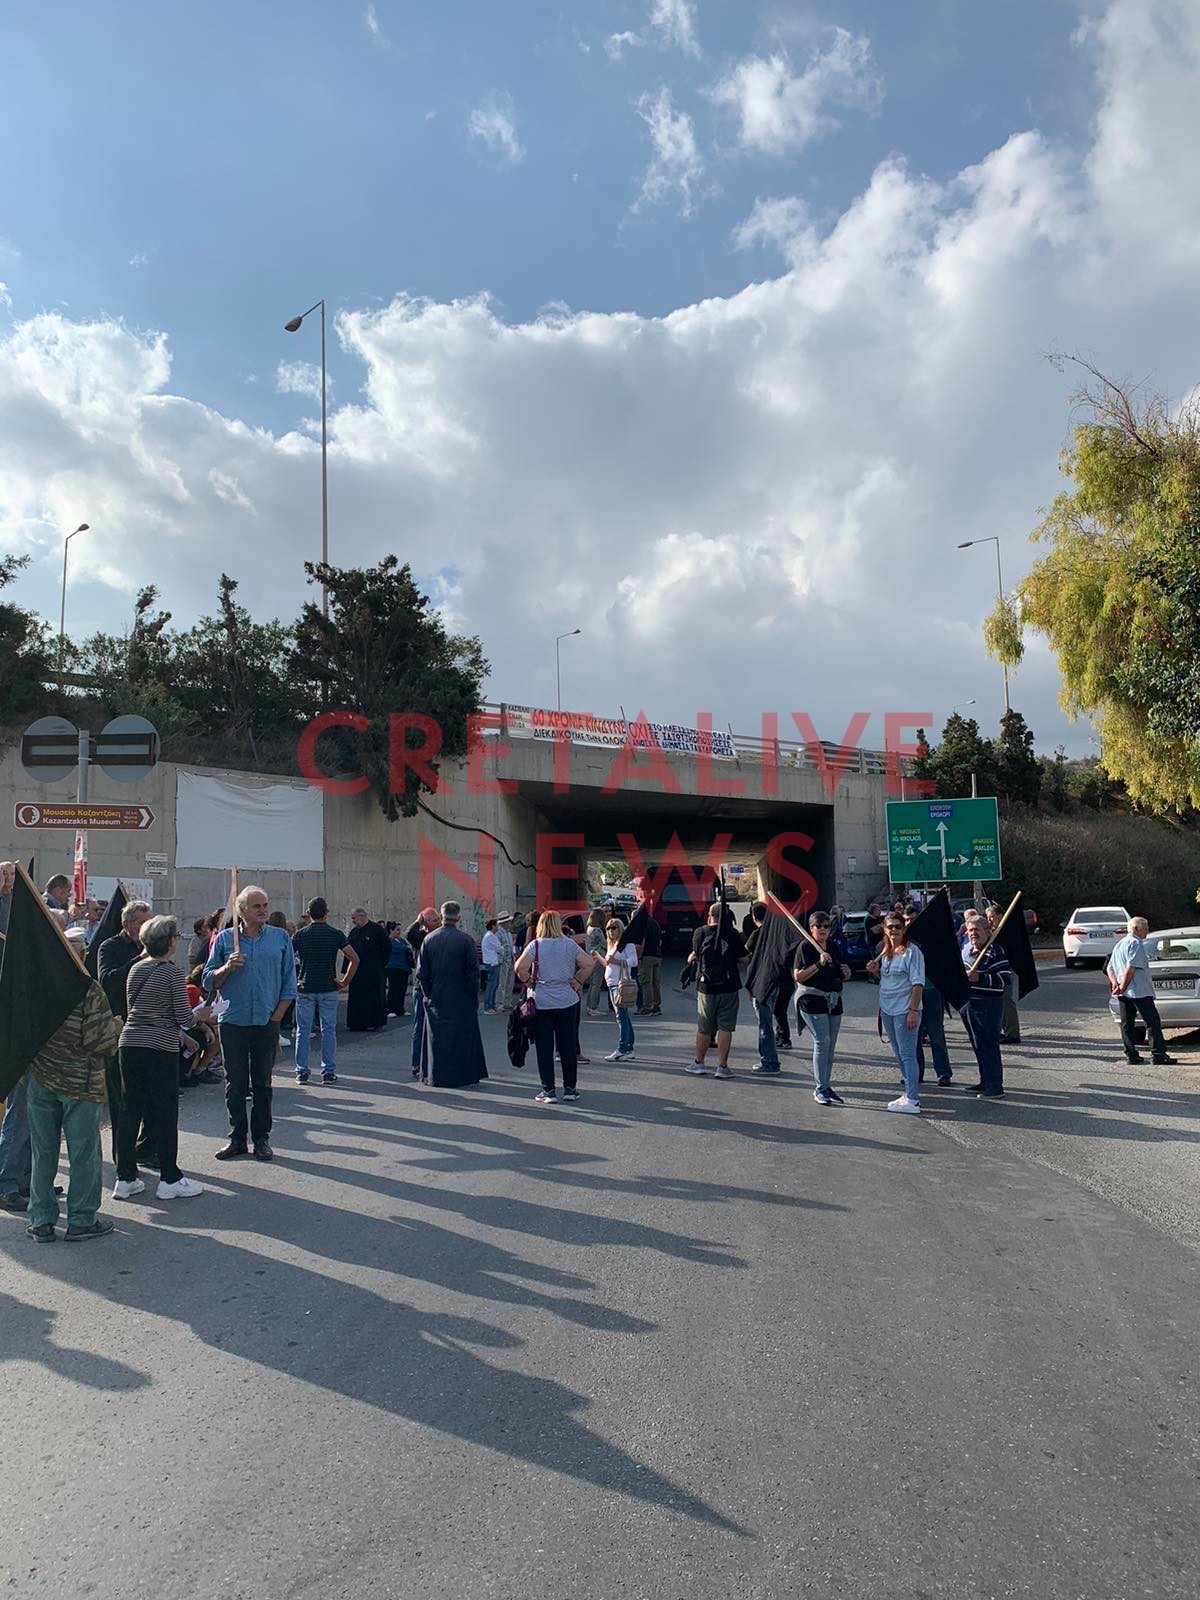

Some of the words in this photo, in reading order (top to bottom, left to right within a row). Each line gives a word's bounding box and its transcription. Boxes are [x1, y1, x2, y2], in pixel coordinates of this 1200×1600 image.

[533, 709, 544, 727] 60
[547, 711, 584, 730] ΧΡΟΝΙΑ
[628, 722, 649, 740] ΟΧΙ
[586, 734, 601, 744] ΤΗΝ
[42, 817, 87, 825] Kazantzakis
[89, 817, 121, 825] Museum
